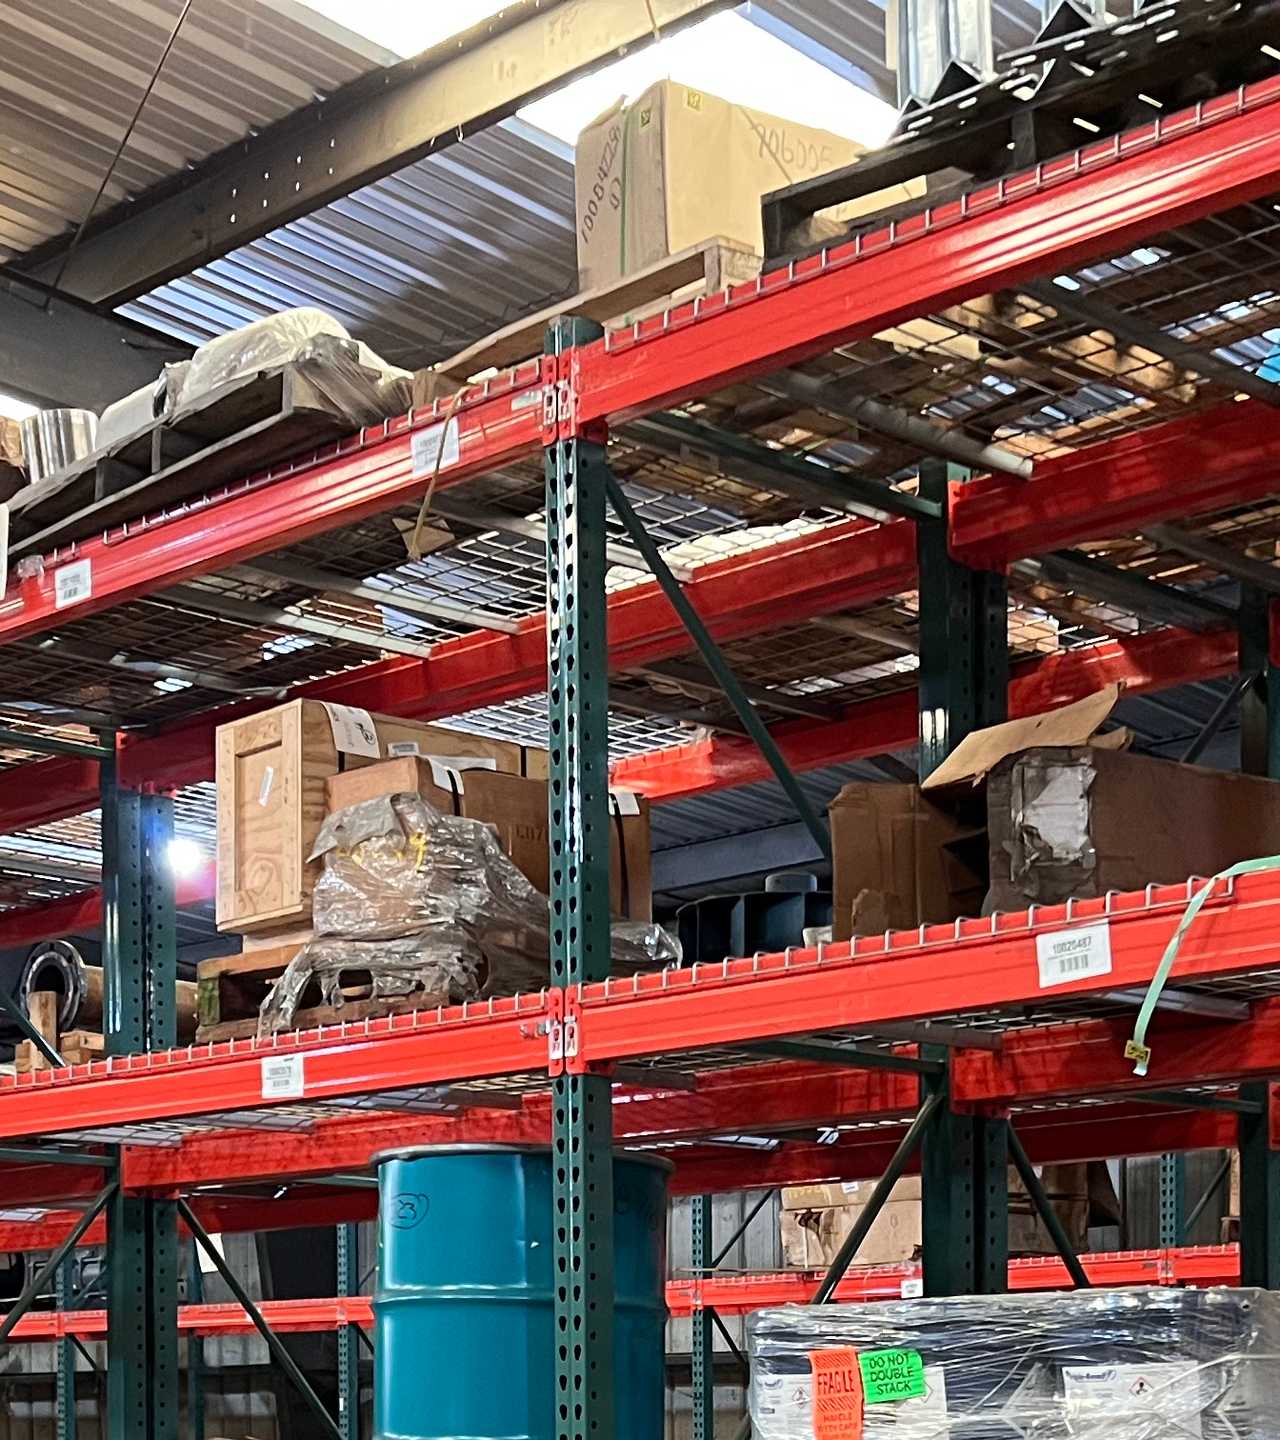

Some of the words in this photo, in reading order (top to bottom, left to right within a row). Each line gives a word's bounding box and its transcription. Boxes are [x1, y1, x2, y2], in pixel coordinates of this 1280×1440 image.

[869, 1356, 885, 1369] DO
[887, 1352, 910, 1365] NOT
[870, 1366, 914, 1382] DOUBLE
[817, 1370, 855, 1395] FRAGILE
[876, 1380, 912, 1395] STACK
